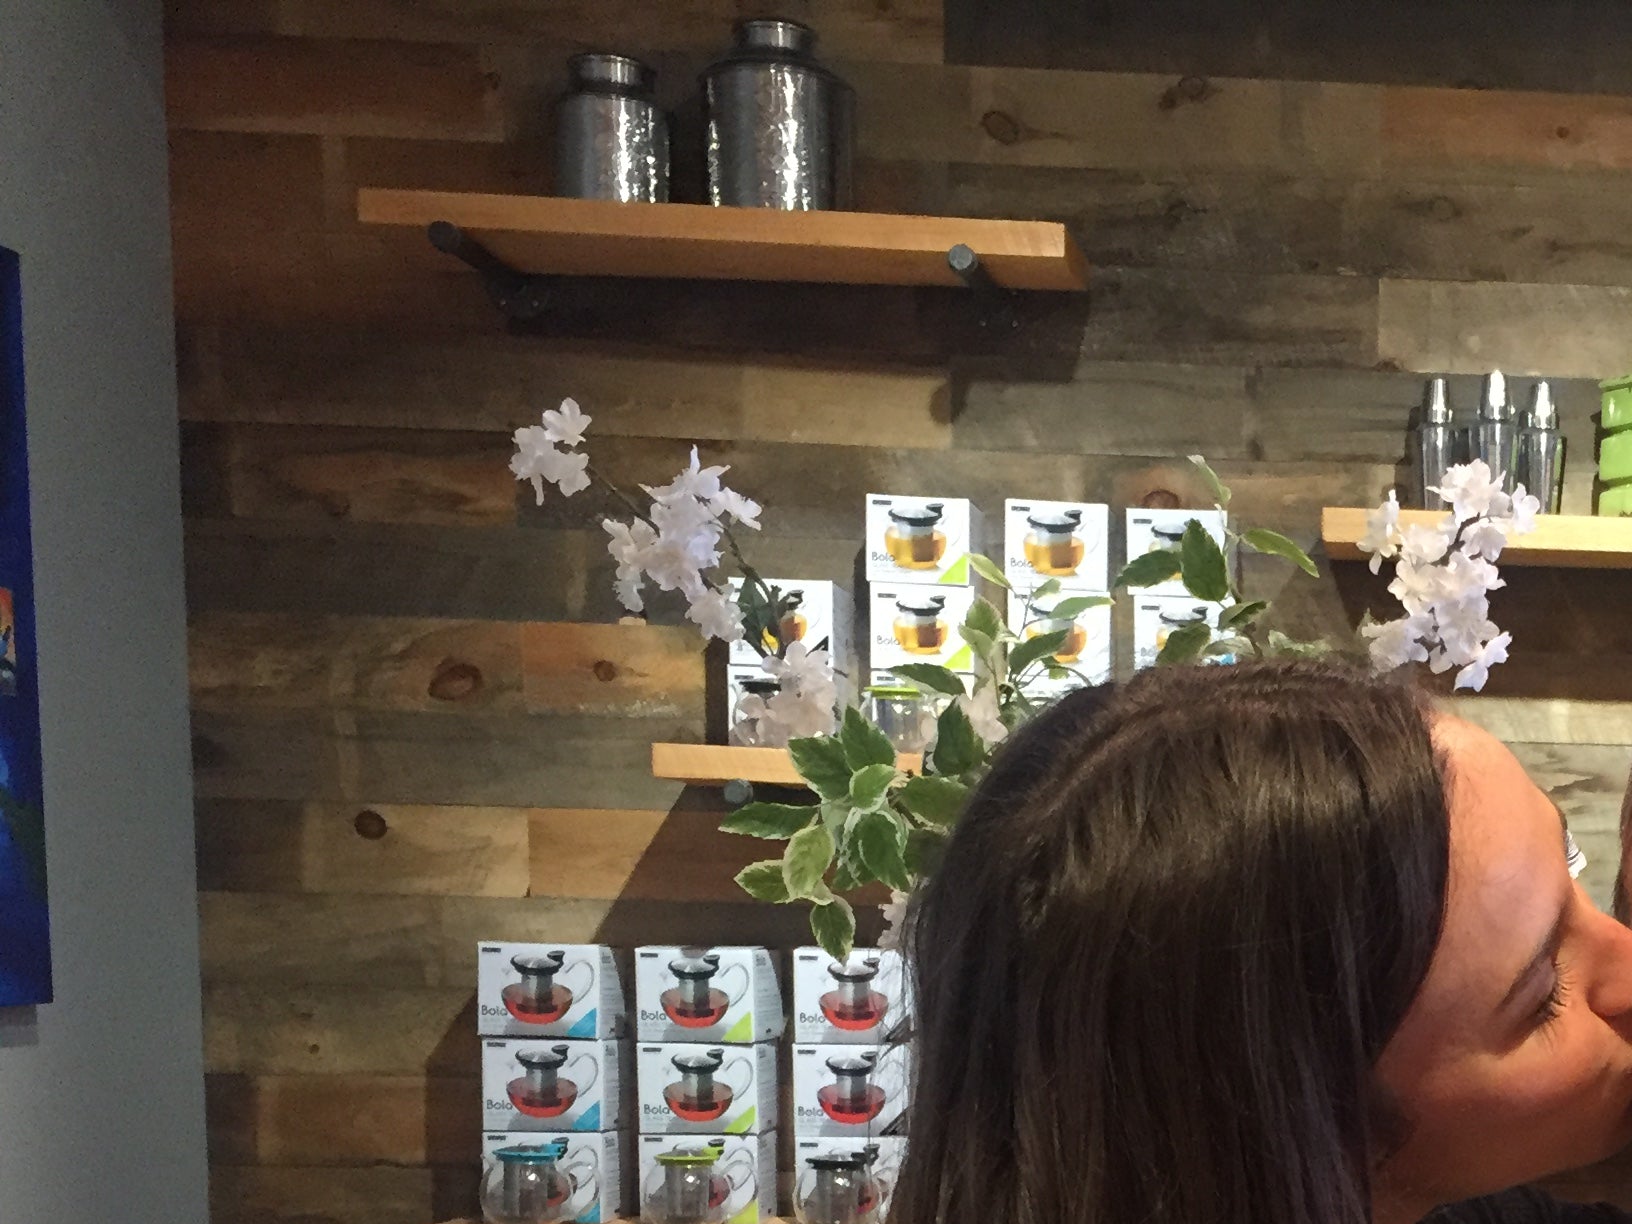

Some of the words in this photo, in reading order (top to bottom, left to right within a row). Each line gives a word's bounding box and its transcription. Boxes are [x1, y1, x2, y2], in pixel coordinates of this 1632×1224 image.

[640, 1009, 667, 1021] Bola
[486, 1099, 513, 1111] Bola
[643, 1103, 670, 1115] Bola
